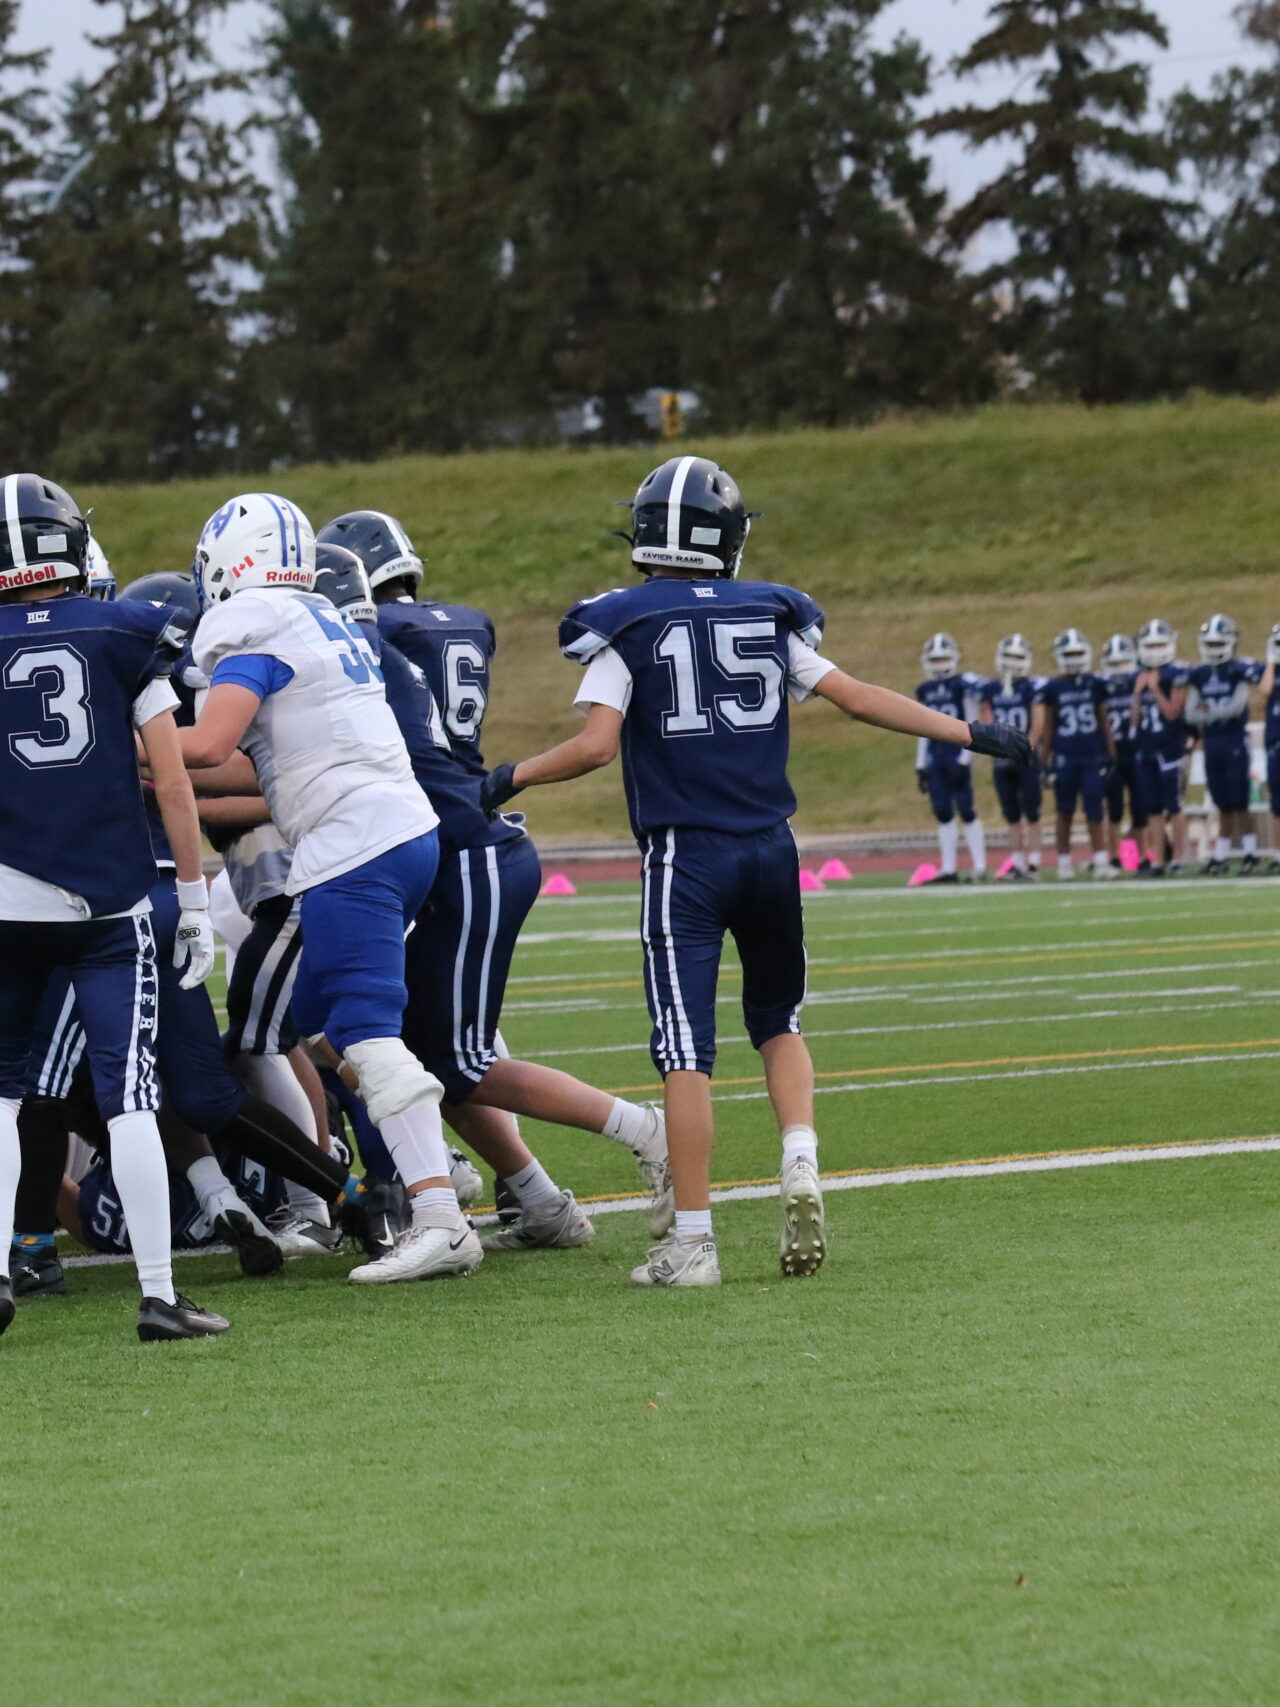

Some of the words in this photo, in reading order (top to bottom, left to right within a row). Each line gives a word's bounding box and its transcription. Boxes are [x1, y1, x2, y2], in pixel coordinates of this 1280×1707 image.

[266, 570, 313, 585] Riddell
[642, 551, 673, 562] XAVIER
[675, 555, 704, 565] RAMS
[3, 642, 96, 770] 3
[442, 638, 488, 742] 6
[653, 615, 786, 739] 15
